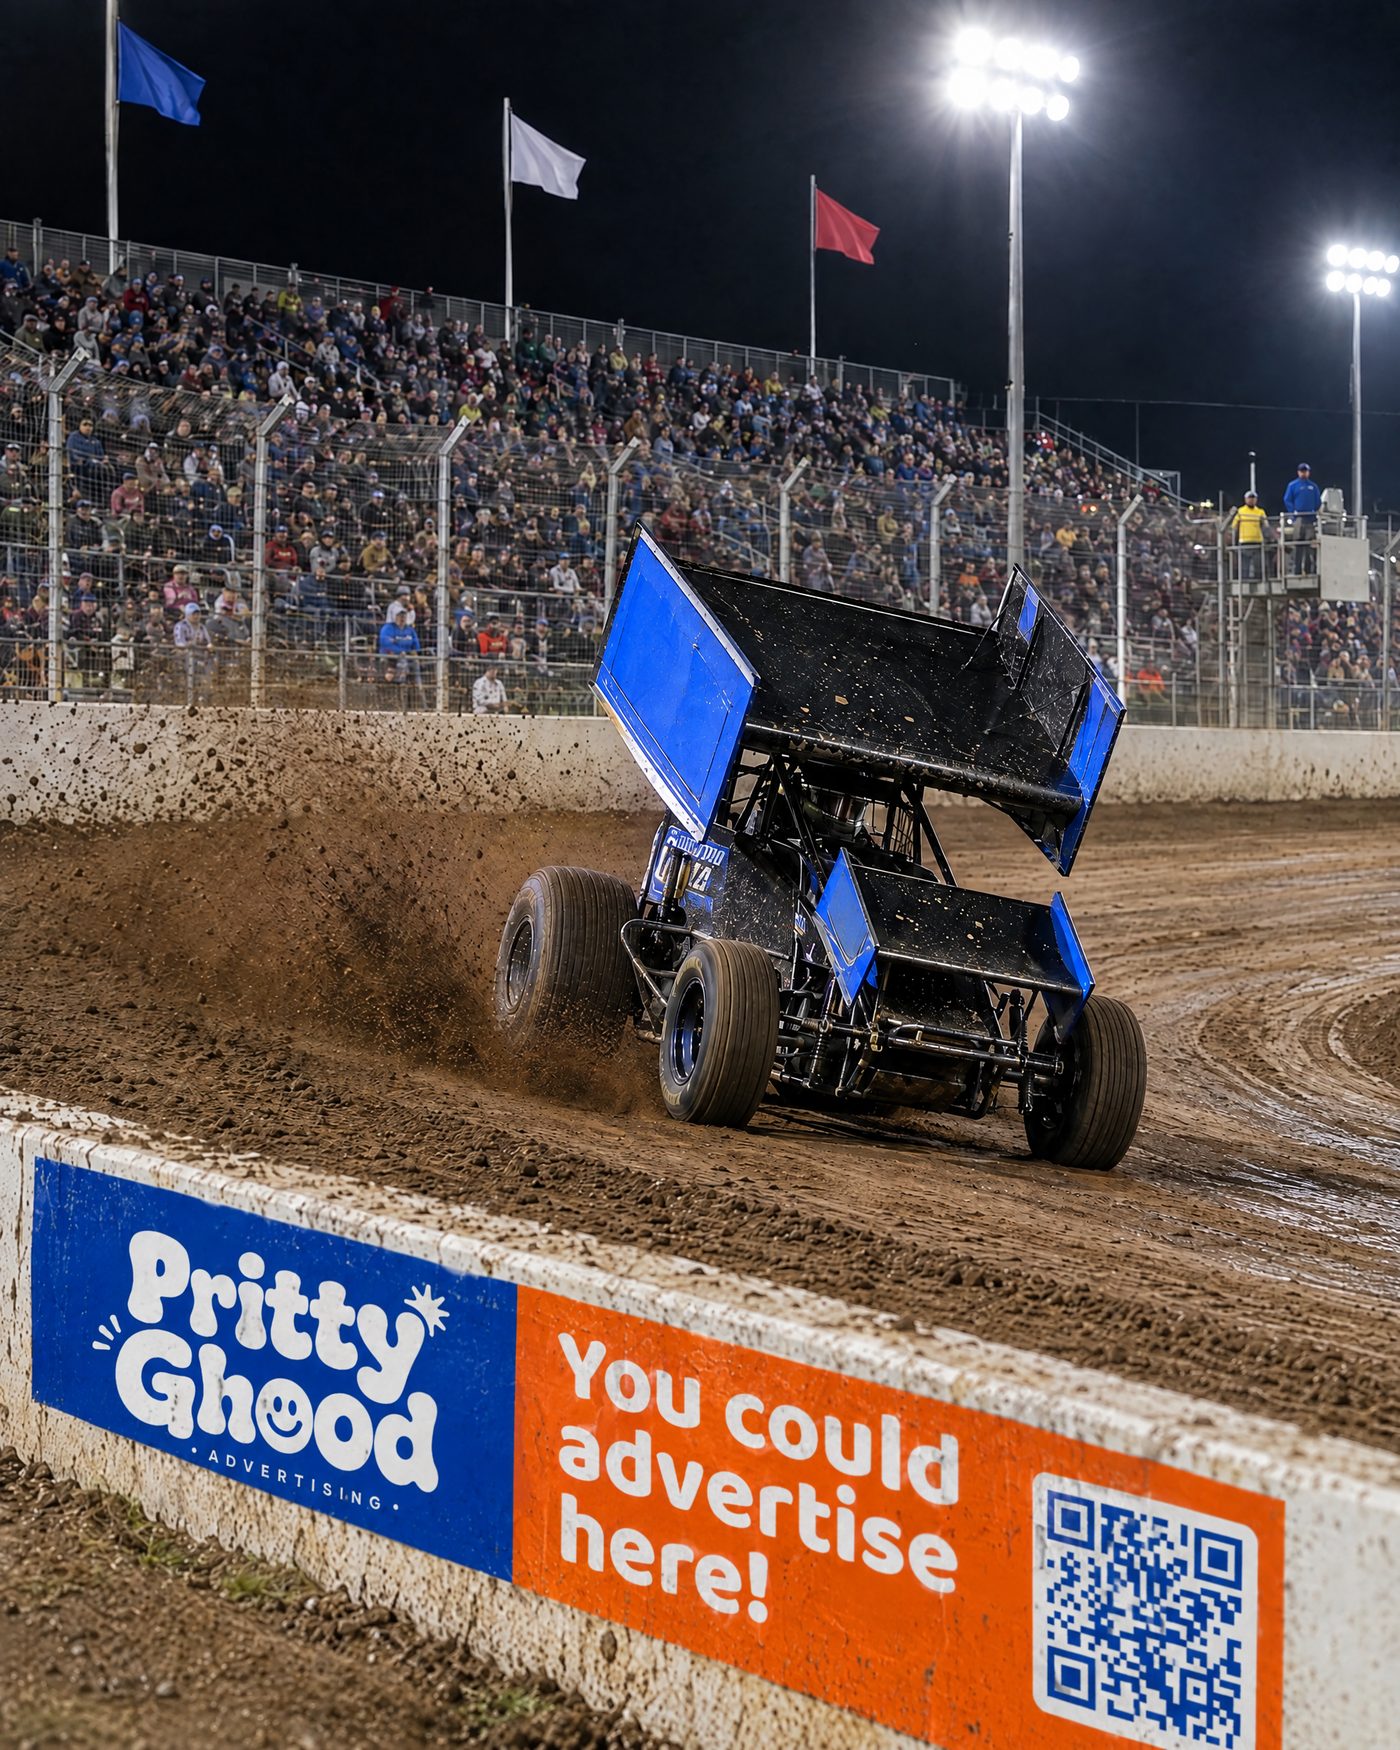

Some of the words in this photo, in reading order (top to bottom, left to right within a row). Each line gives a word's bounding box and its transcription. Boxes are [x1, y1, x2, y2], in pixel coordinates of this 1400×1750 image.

[128, 1231, 425, 1404] Pritty
[116, 1329, 439, 1493] Ghood
[208, 1449, 382, 1510] ADVERTISING
[558, 1333, 701, 1428] You
[725, 1393, 959, 1505] could
[558, 1426, 958, 1594] advertise
[561, 1493, 769, 1624] here!
